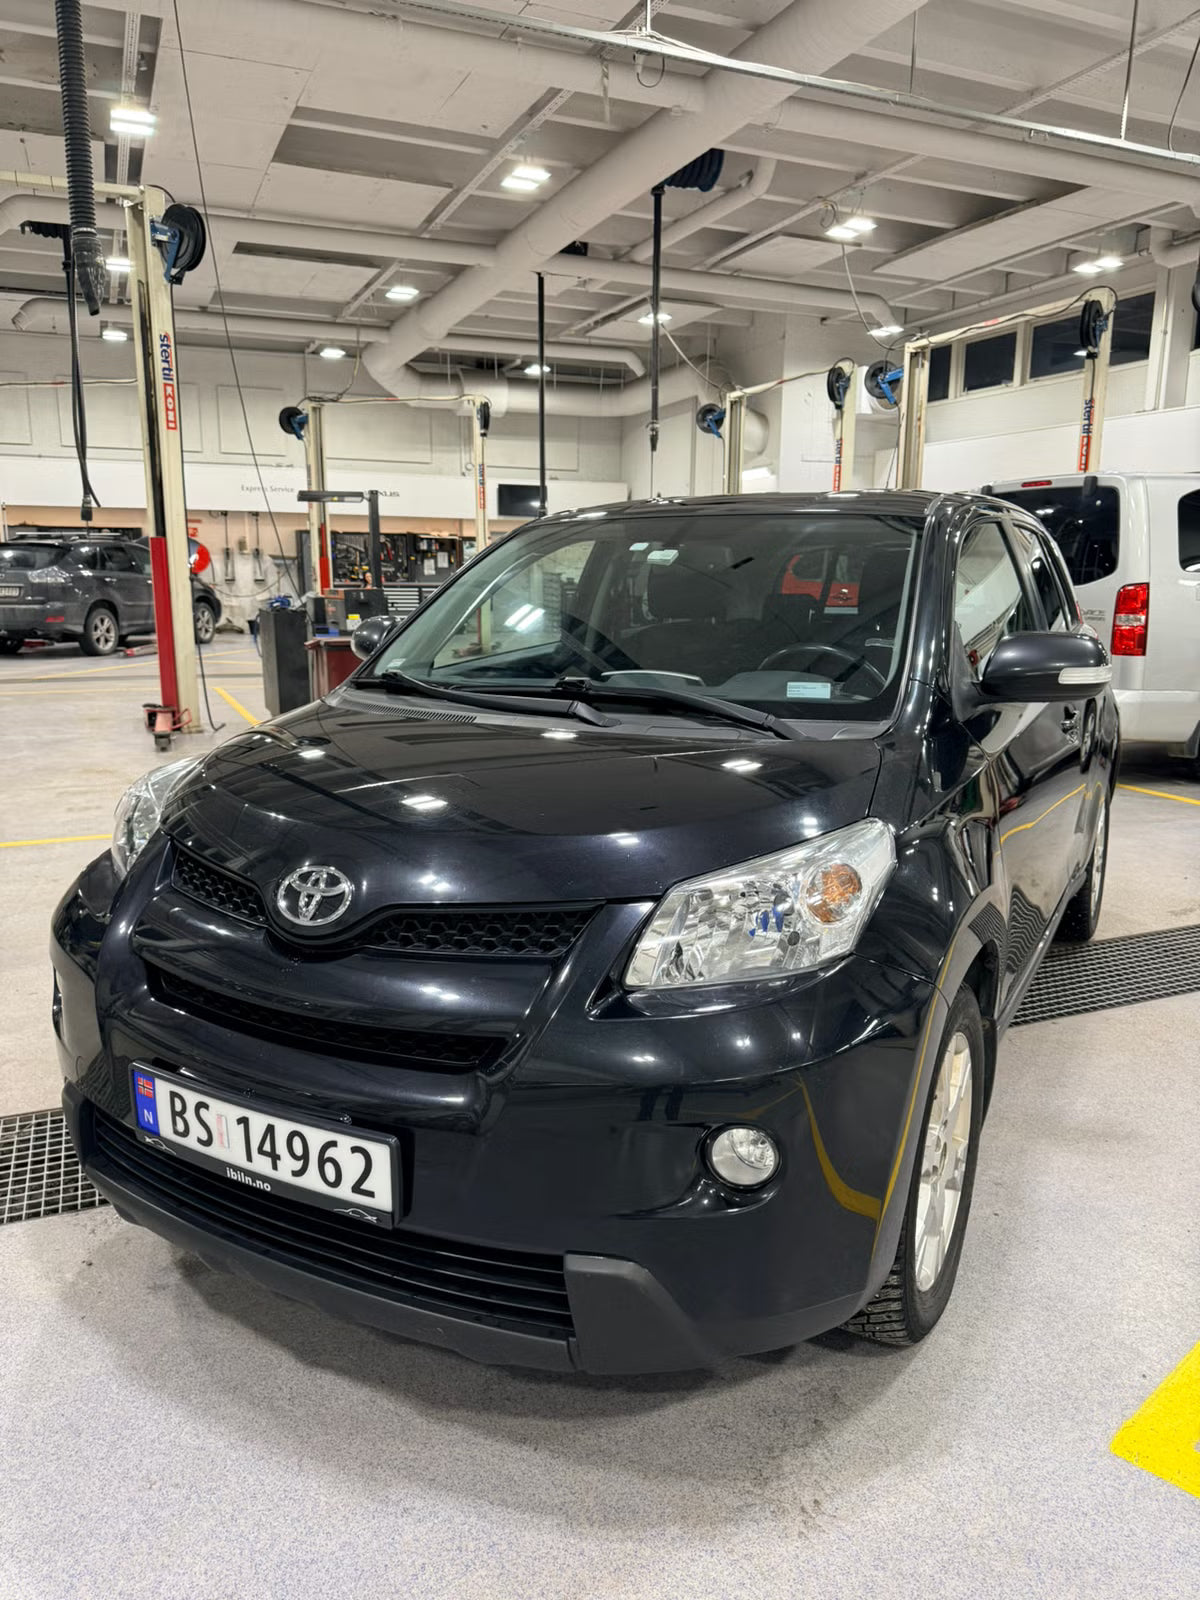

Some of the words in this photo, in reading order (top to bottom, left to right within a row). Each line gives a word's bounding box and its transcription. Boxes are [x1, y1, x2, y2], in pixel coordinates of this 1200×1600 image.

[160, 332, 174, 382] stertil
[165, 384, 177, 430] KONI
[270, 486, 294, 494] Service
[143, 1110, 154, 1125] N
[169, 1090, 214, 1147] BS
[236, 1116, 376, 1198] 14962
[226, 1167, 271, 1191] ibiln.no
